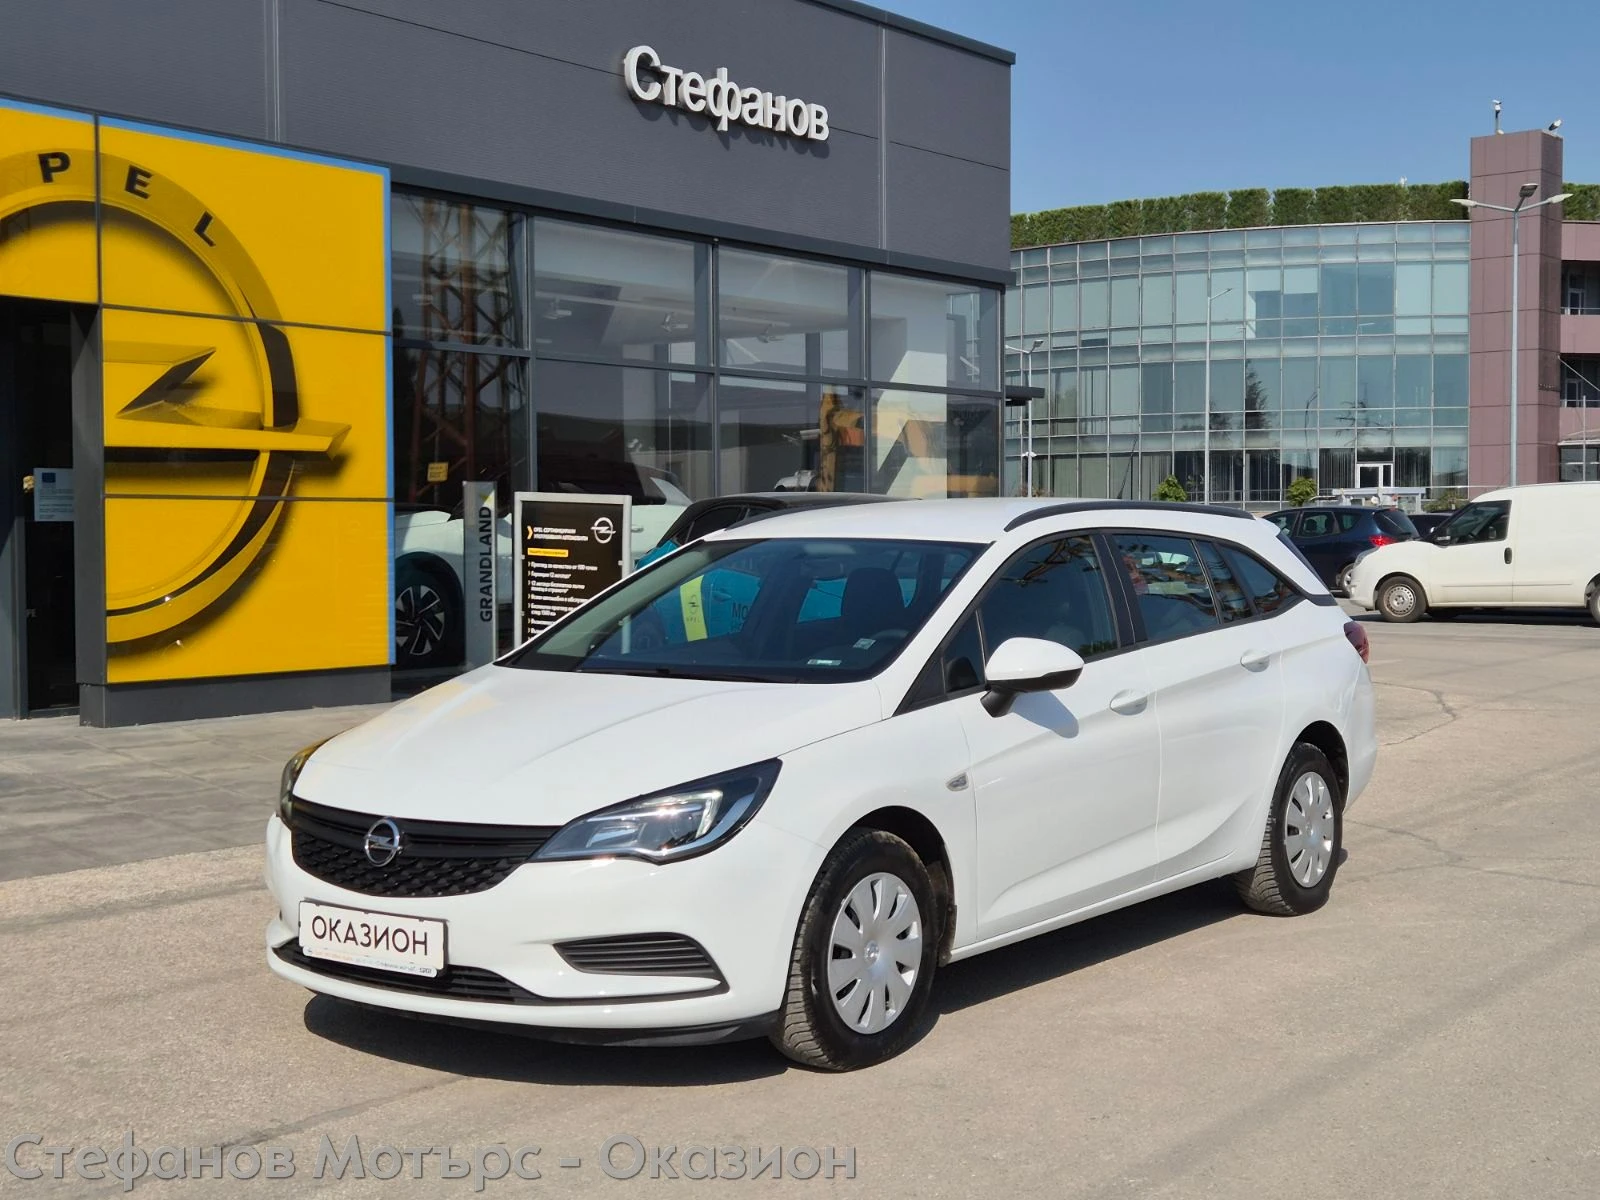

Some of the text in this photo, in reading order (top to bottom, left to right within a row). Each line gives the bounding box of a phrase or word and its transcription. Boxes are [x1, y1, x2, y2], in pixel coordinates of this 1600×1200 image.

[623, 45, 830, 141] Стефанов
[479, 506, 493, 622] GRANDLAND
[312, 915, 428, 956] ОКАЗИОН
